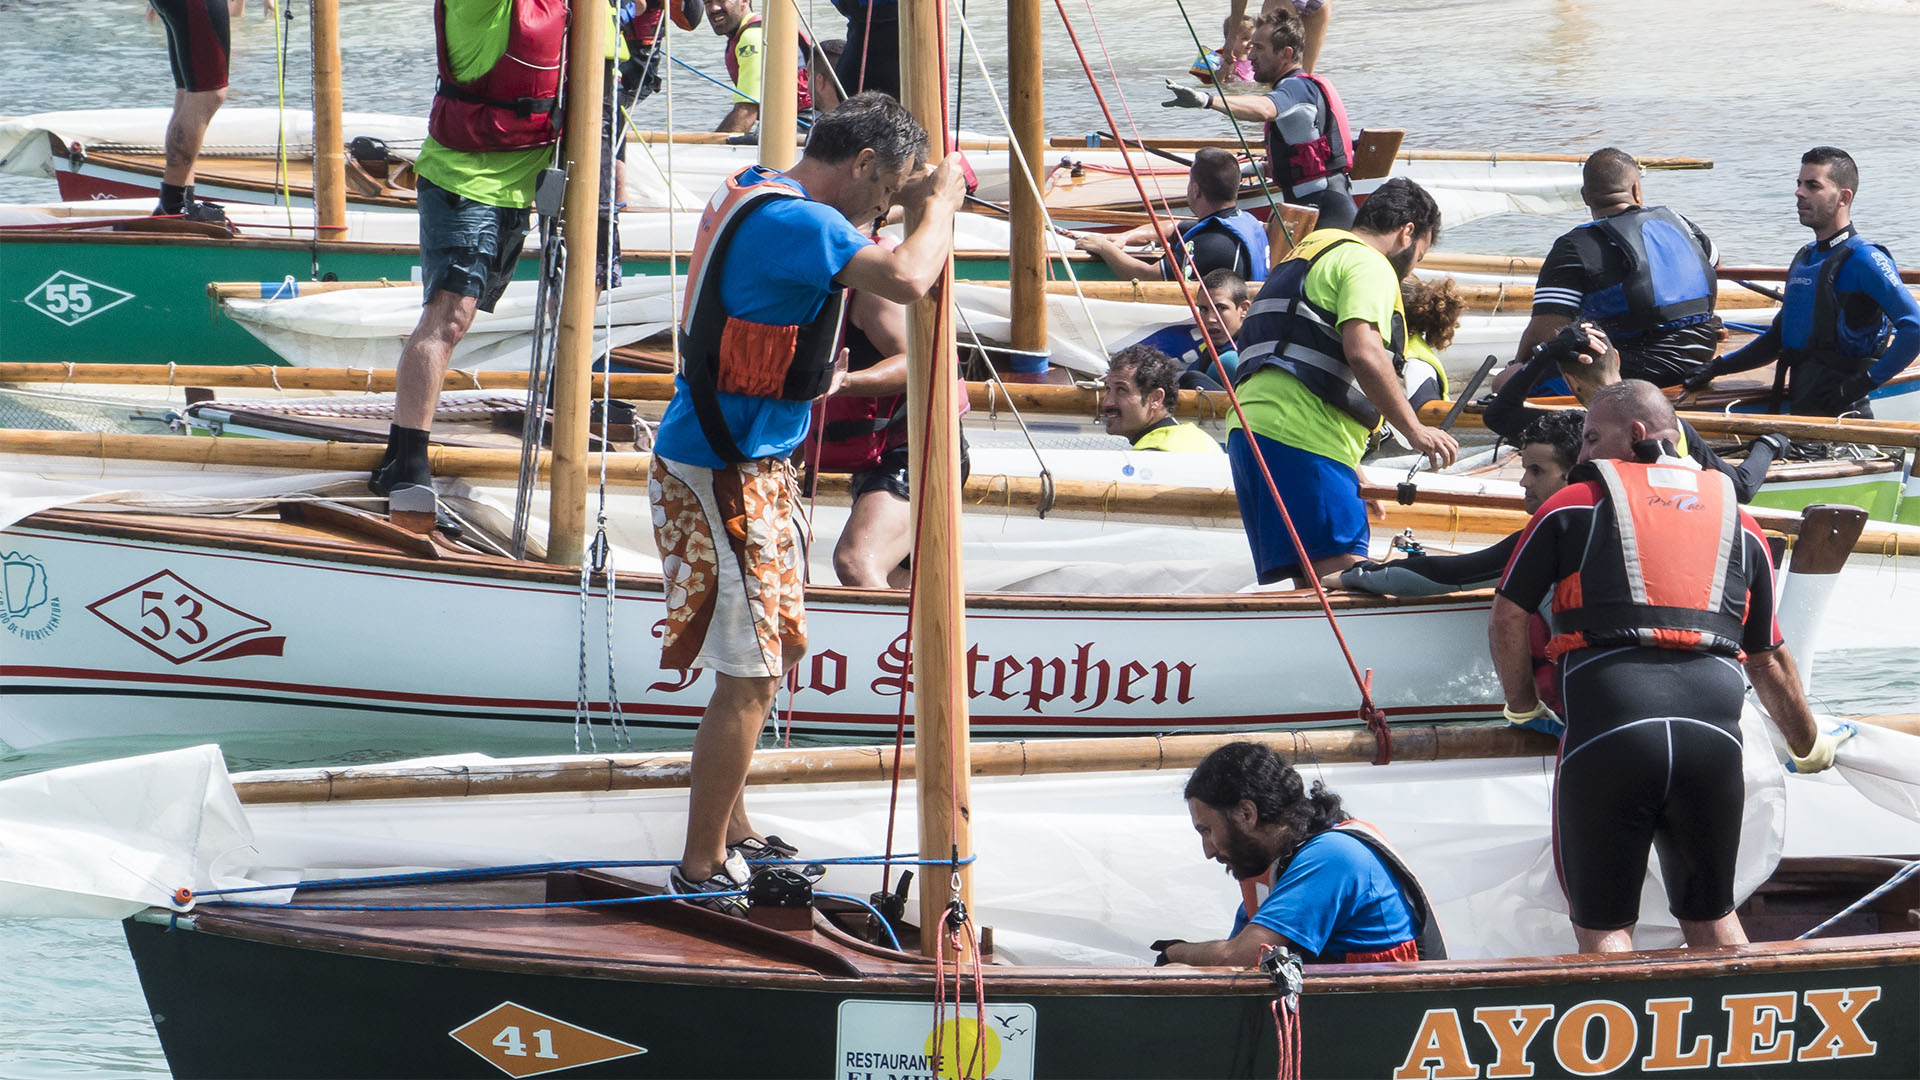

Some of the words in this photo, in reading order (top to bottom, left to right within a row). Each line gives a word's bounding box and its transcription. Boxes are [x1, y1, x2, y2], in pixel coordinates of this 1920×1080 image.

[46, 284, 92, 314] 55
[140, 590, 208, 645] 53
[492, 1025, 559, 1060] 41
[1393, 985, 1882, 1080] AYOLEX
